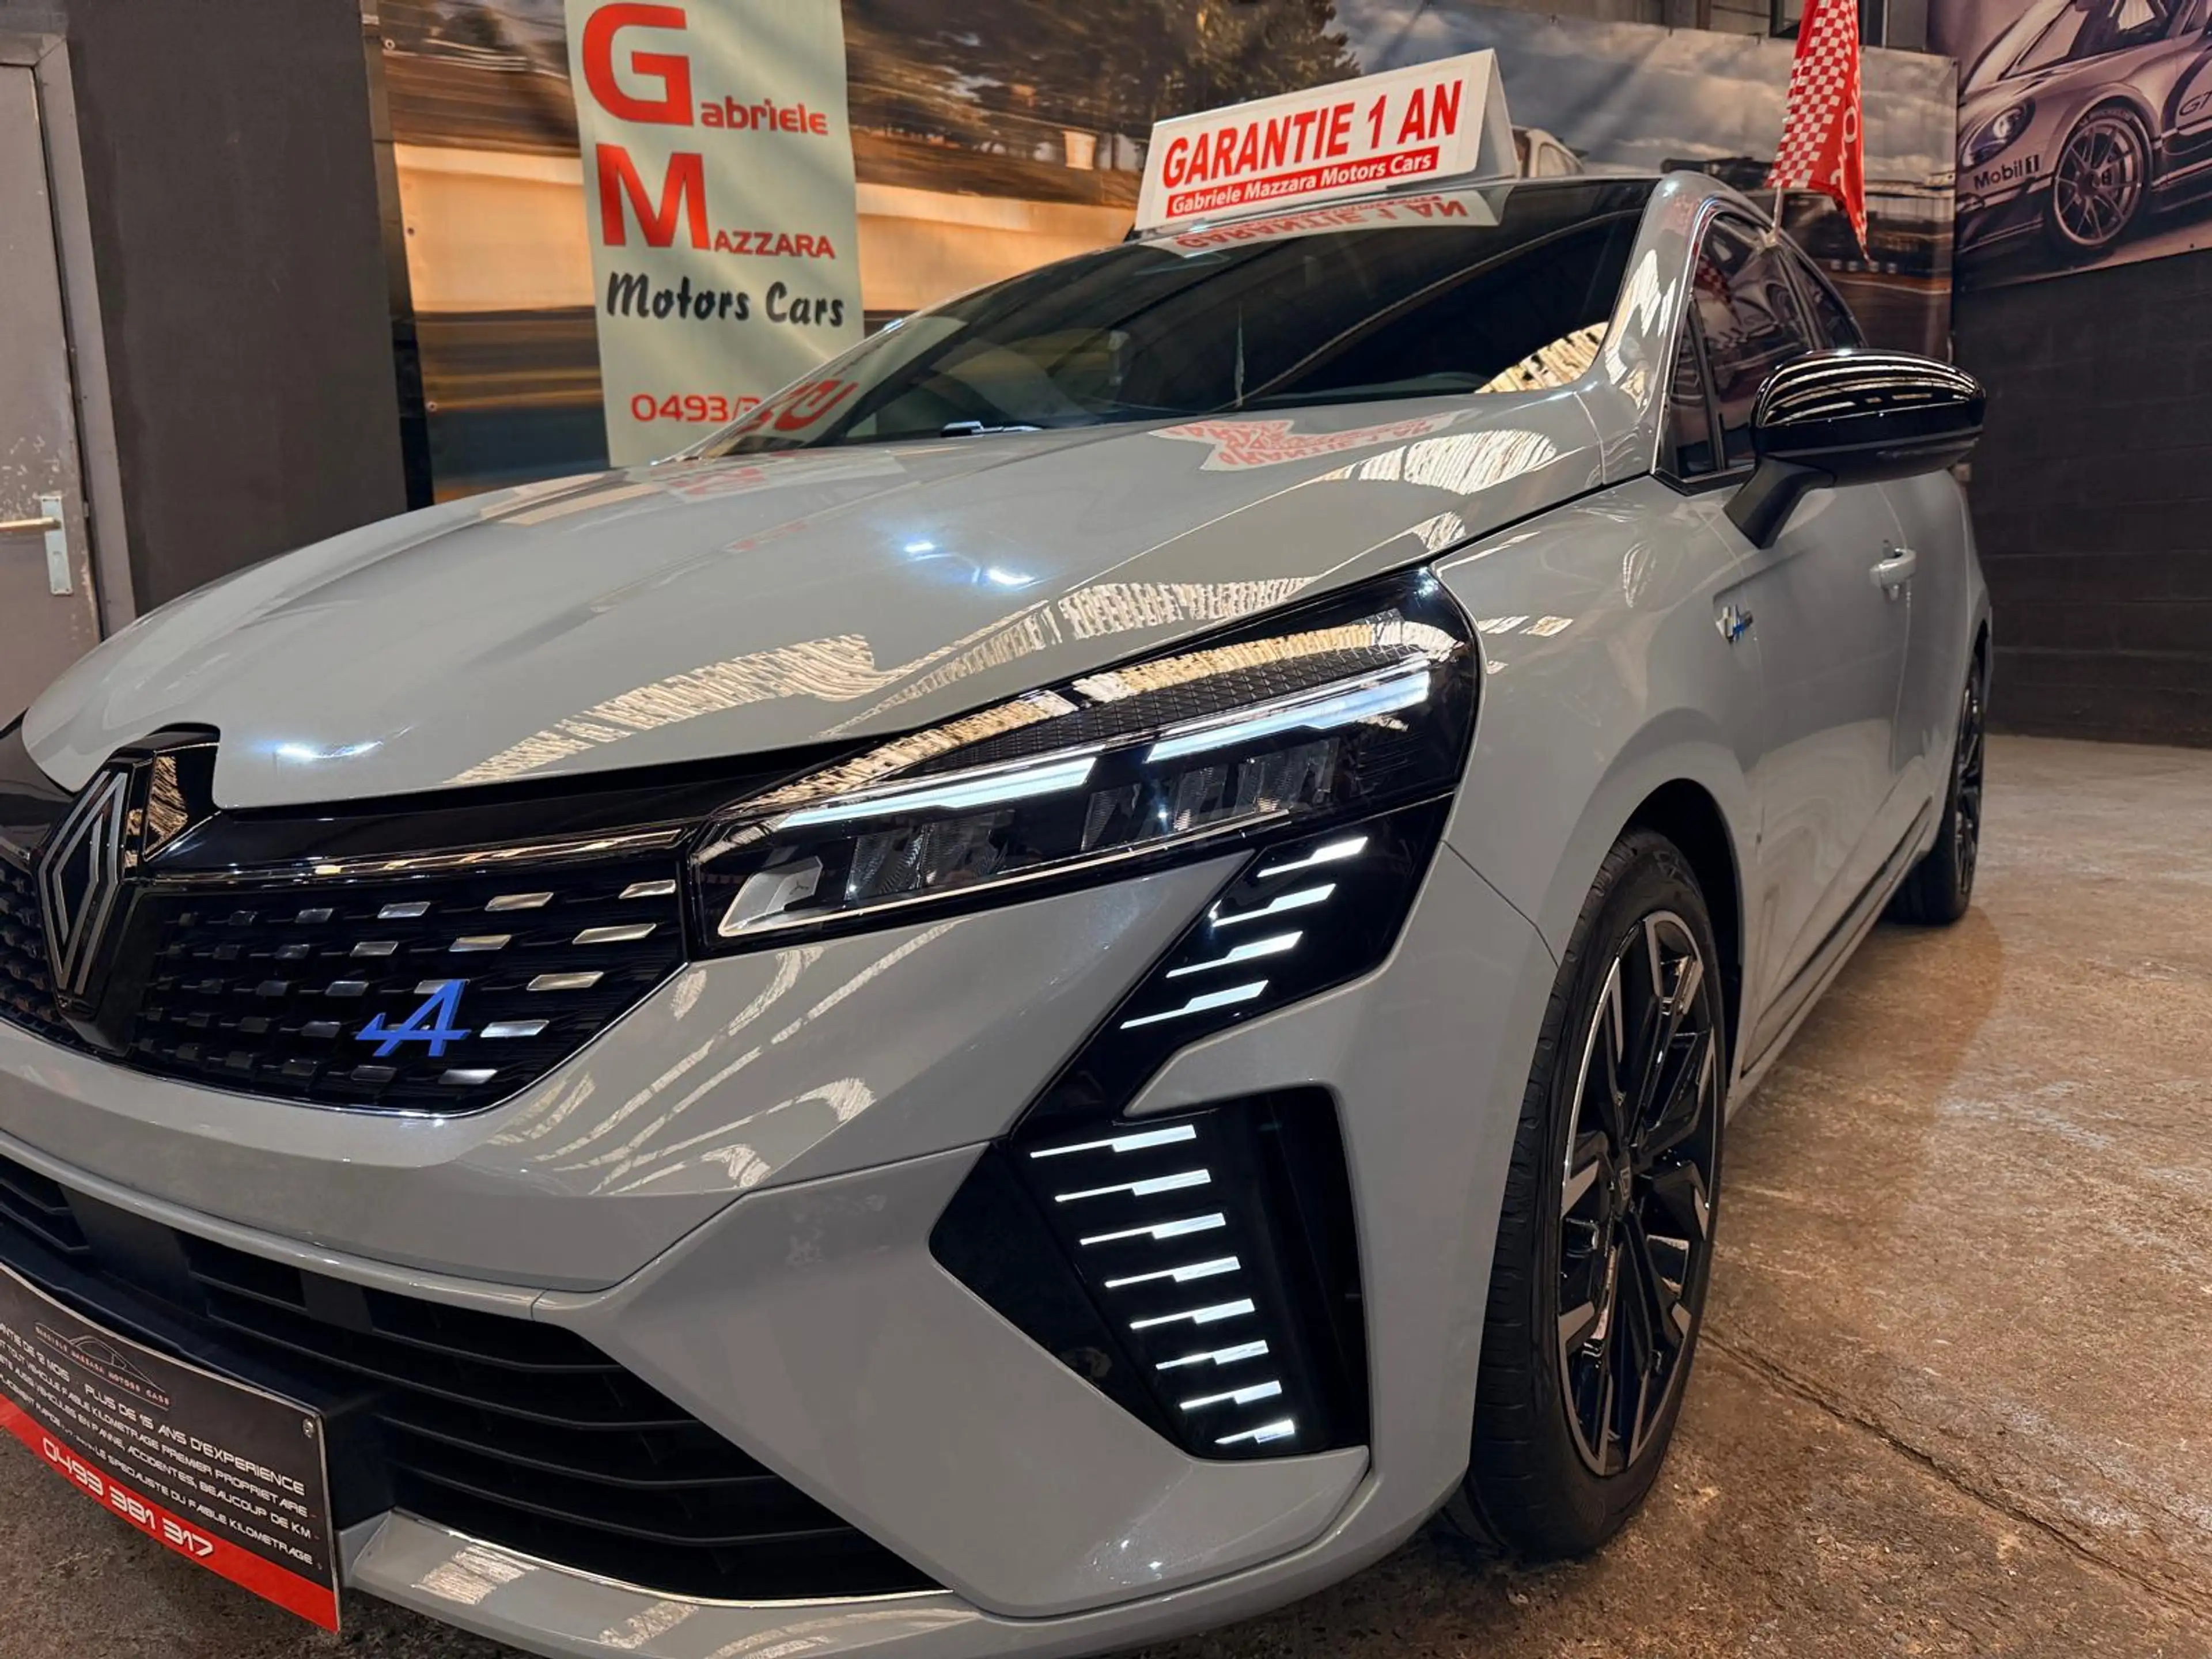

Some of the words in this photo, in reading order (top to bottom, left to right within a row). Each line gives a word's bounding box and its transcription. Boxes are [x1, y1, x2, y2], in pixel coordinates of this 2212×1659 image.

[1162, 101, 1355, 189] GARANTIE
[1367, 94, 1387, 150] 1
[1397, 79, 1462, 145] AN
[595, 143, 835, 259] MAZZARA
[1172, 189, 1241, 215] Gabriele
[1244, 172, 1317, 199] Mazzara
[1320, 162, 1386, 188] Motors
[1390, 153, 1431, 174] Cars
[607, 271, 749, 321] Motors
[765, 281, 844, 328] Cars
[85, 1383, 116, 1410] PLUS
[118, 1403, 137, 1422] DE
[139, 1414, 154, 1430] 15
[158, 1424, 187, 1445] ANS
[190, 1437, 305, 1496] D'EXPERIENCE
[161, 1445, 213, 1476] PREMIER
[42, 1437, 103, 1497] 0493
[109, 1484, 157, 1530] 381
[162, 1516, 214, 1556] 317
[199, 1480, 267, 1516] BEAUCOUP
[270, 1512, 289, 1528] DE
[291, 1522, 312, 1539] KM
